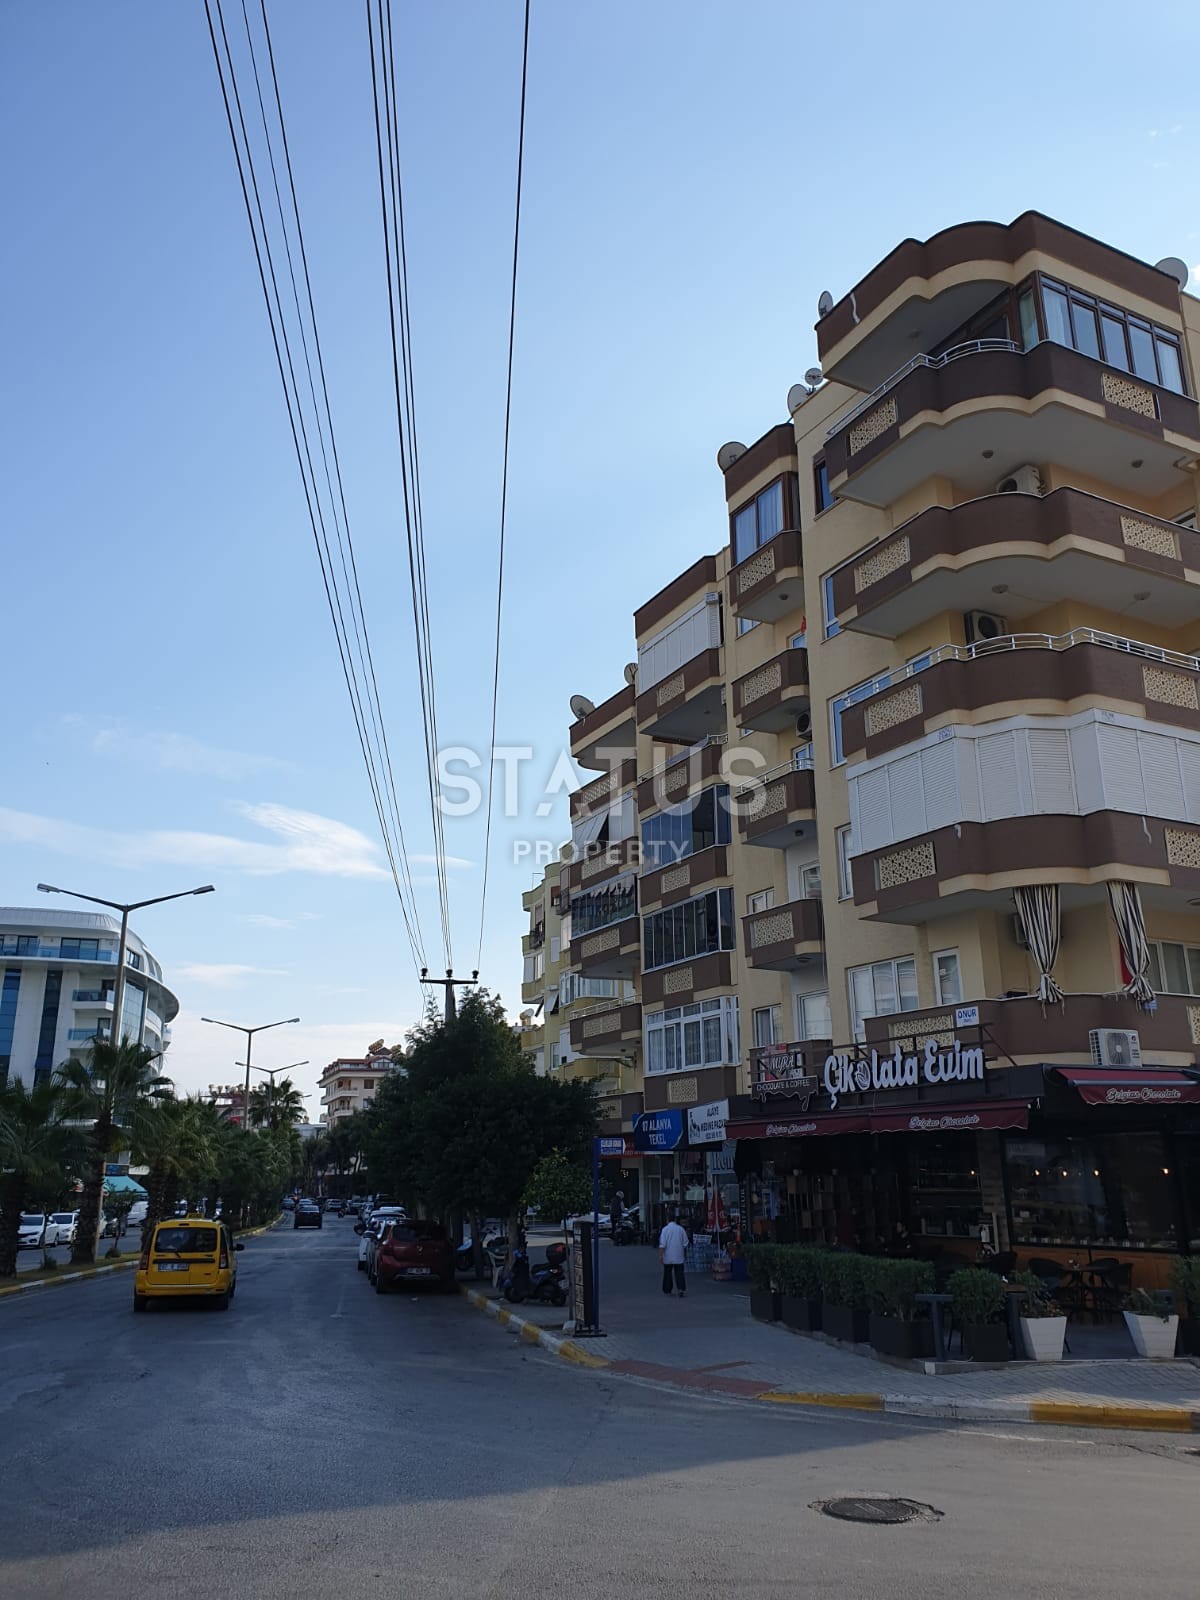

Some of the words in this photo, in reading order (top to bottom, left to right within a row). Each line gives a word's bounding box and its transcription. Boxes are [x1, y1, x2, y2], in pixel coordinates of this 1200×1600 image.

[957, 1008, 977, 1019] ONUR
[924, 1040, 984, 1084] Evim
[790, 1078, 810, 1088] COFFEE
[649, 1117, 673, 1131] ALANYA
[648, 1133, 667, 1145] TEKEL
